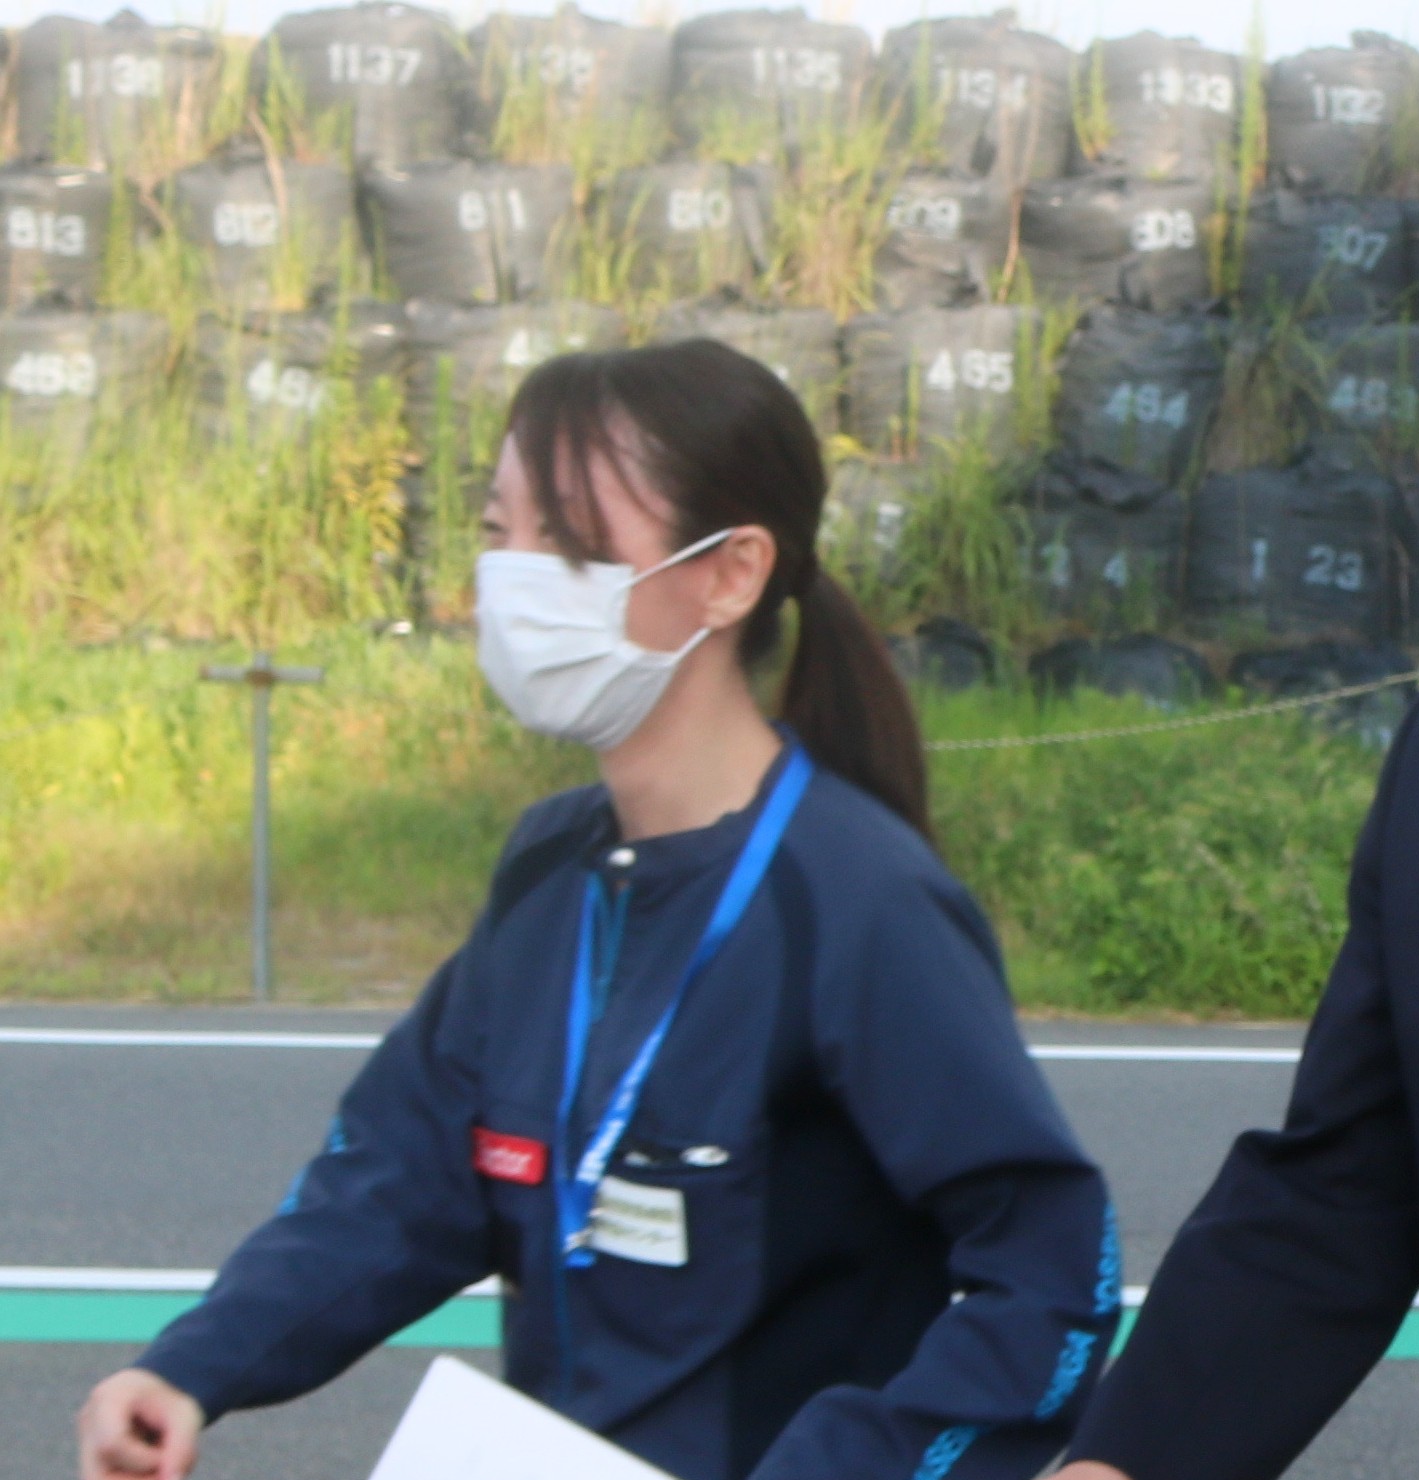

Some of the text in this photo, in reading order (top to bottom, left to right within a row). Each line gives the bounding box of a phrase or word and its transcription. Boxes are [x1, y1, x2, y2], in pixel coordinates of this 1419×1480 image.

[328, 42, 421, 85] 1137
[752, 46, 841, 92] 1135
[1139, 66, 1233, 113] 1133
[7, 206, 86, 257] 813
[212, 202, 279, 247] 812
[1131, 209, 1197, 253] 808
[926, 348, 1013, 394] 465
